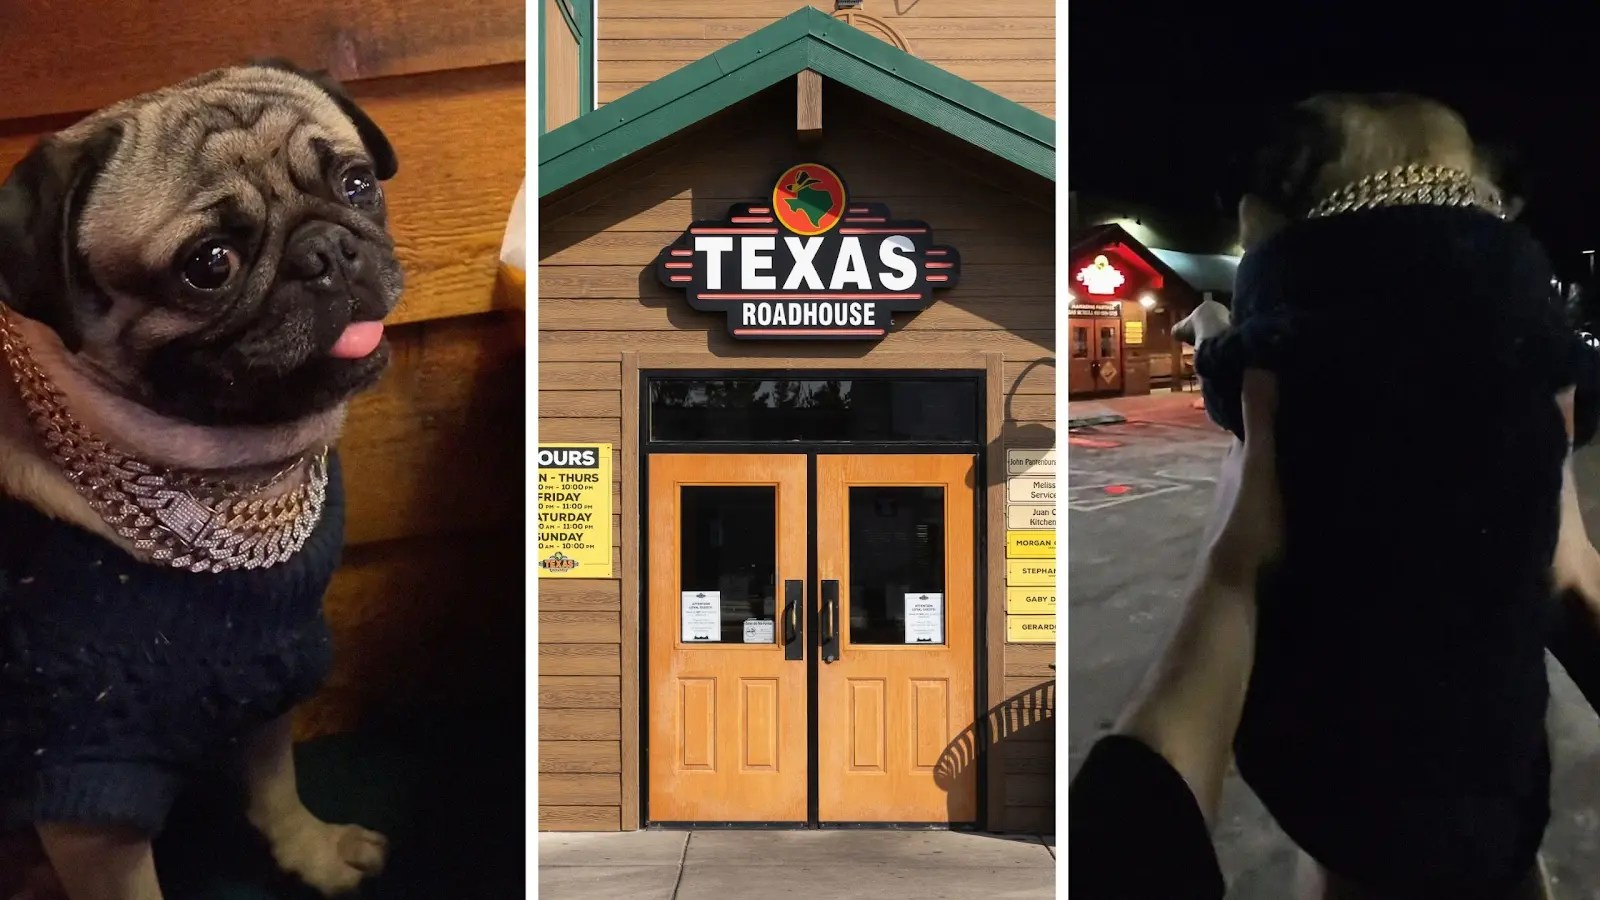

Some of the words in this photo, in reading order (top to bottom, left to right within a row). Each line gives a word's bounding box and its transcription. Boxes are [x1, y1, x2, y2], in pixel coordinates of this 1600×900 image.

[694, 235, 918, 291] TEXAS
[742, 302, 876, 326] ROADHOUSE
[538, 450, 595, 466] OURS
[559, 473, 599, 482] THURS
[538, 493, 581, 501] FRIDAY
[545, 560, 574, 568] TEXAS
